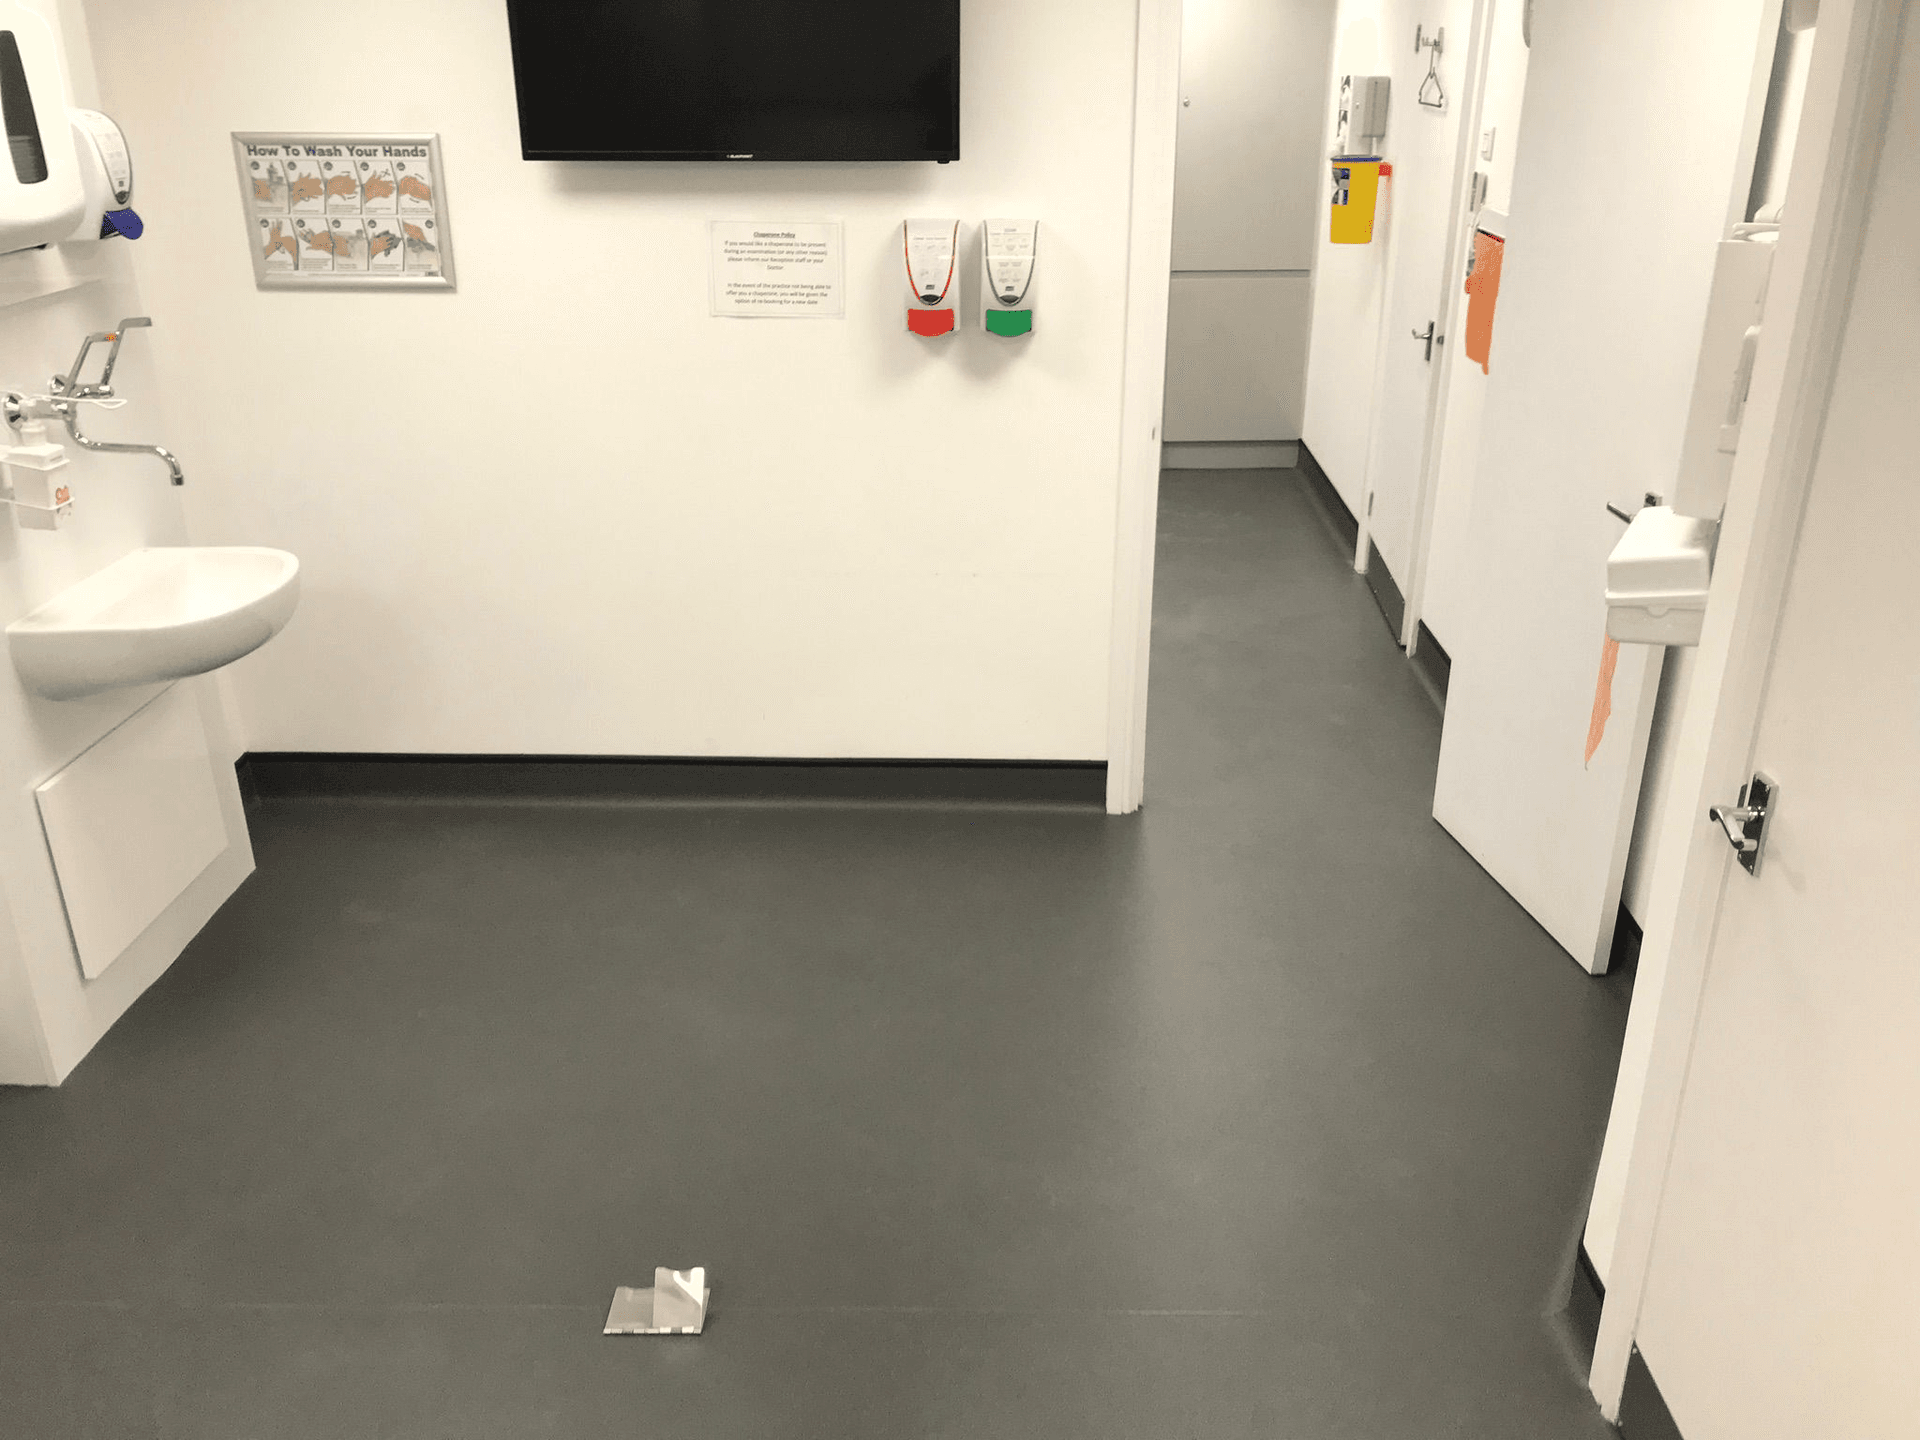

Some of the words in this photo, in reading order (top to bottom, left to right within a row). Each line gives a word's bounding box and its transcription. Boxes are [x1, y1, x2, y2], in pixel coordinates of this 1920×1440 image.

[247, 145, 278, 156] How
[282, 145, 300, 156] To
[303, 145, 342, 157] Wash
[346, 146, 378, 157] Your
[382, 146, 427, 157] Hands
